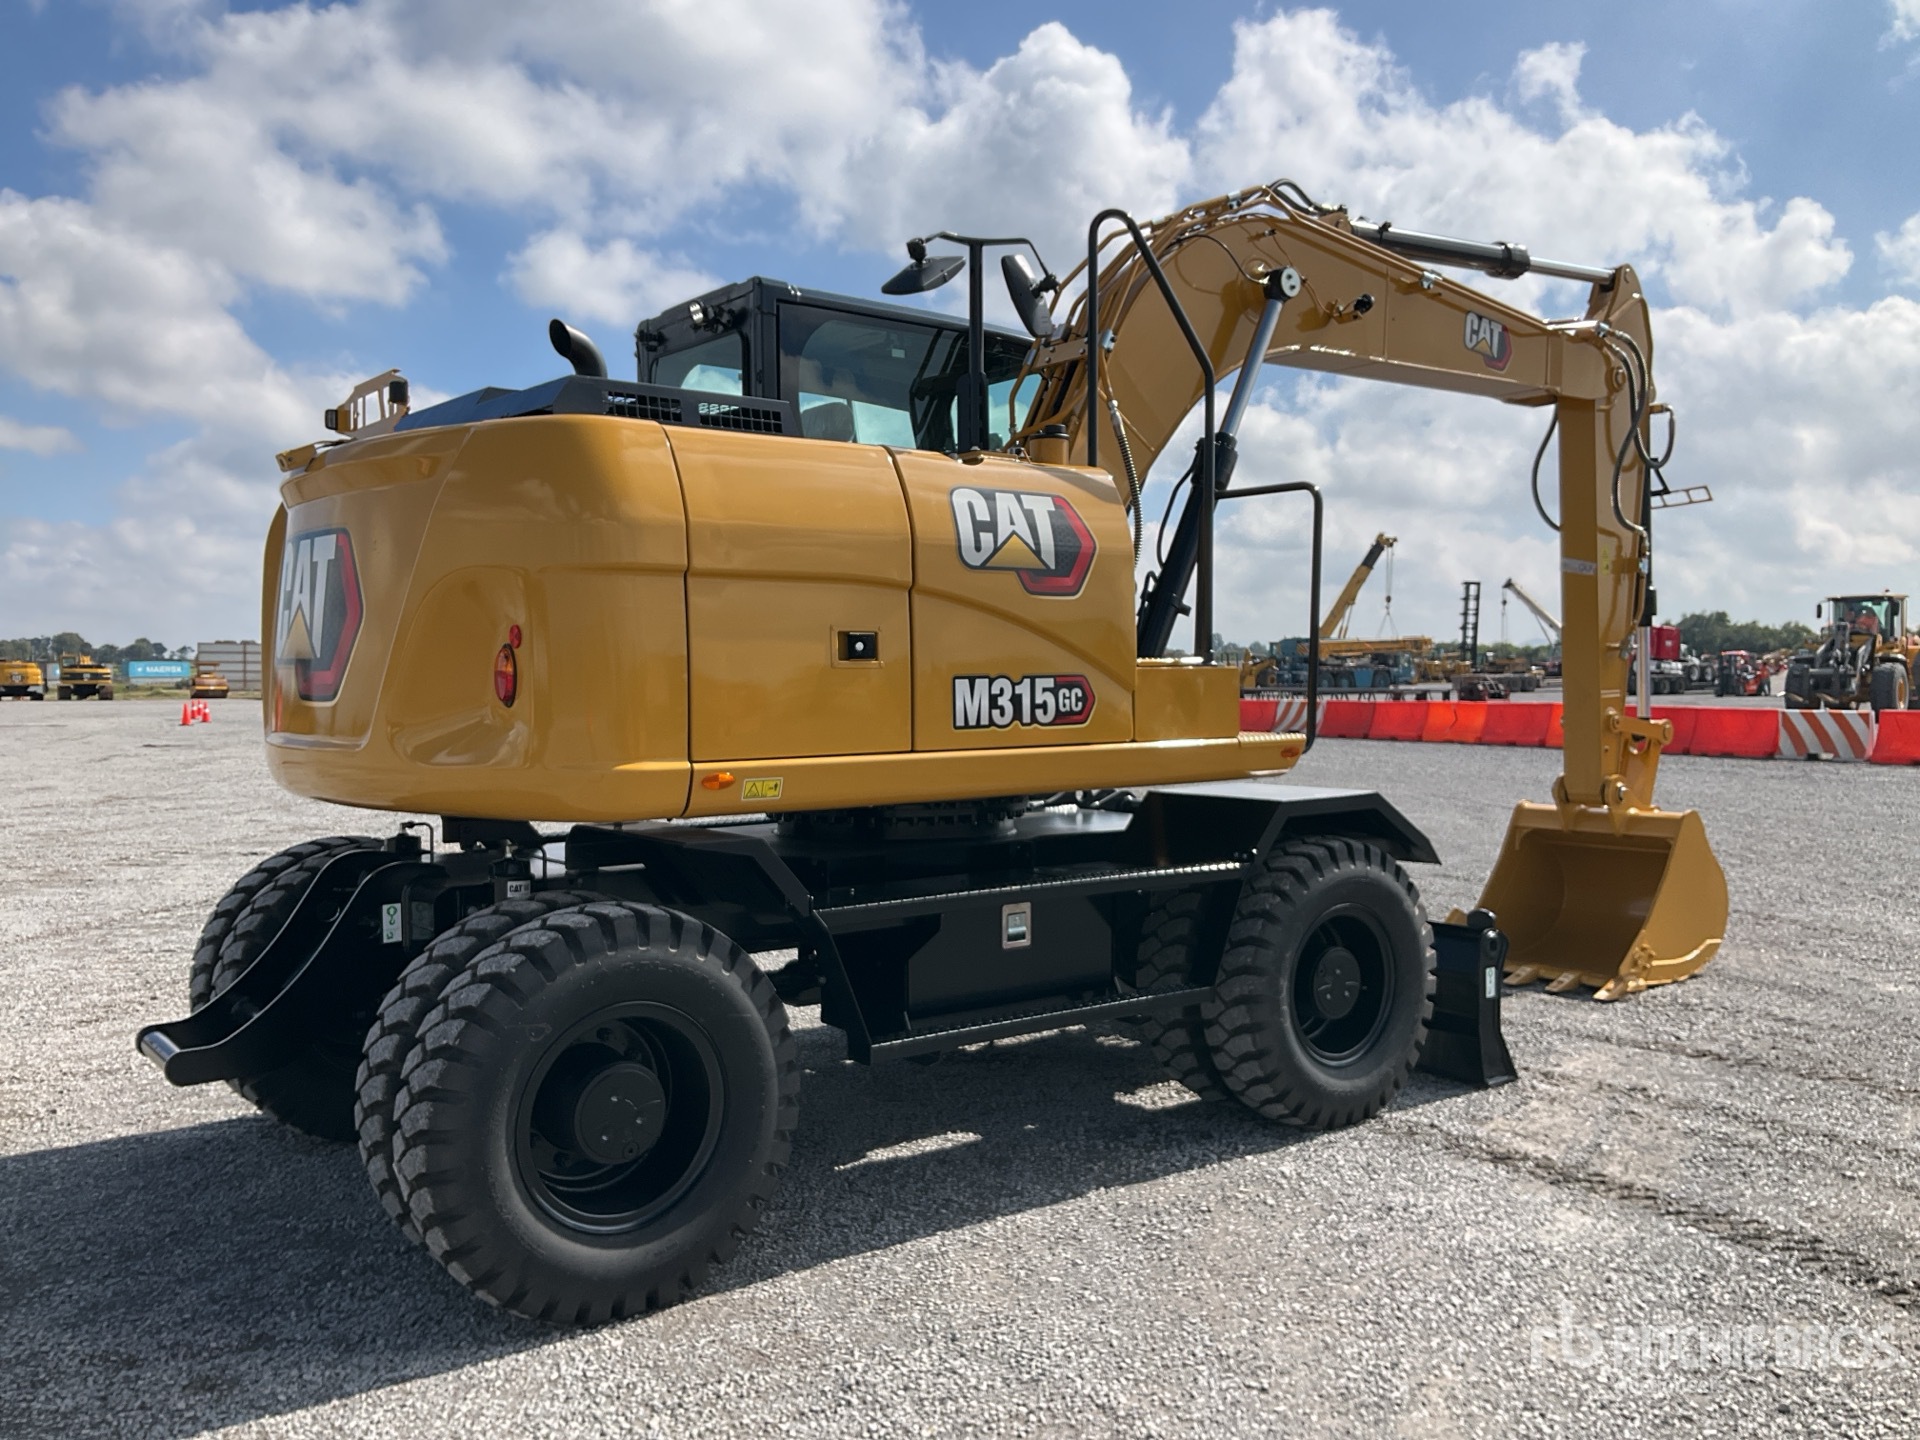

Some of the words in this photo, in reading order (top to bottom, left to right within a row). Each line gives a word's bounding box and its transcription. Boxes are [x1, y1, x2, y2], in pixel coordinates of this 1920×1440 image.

[1465, 311, 1503, 359] CAT
[952, 488, 1056, 570] CAT
[276, 533, 337, 660] CAT
[145, 665, 182, 673] MAERSK
[954, 677, 1056, 727] M315
[1058, 687, 1083, 713] GC
[509, 884, 523, 892] CAT
